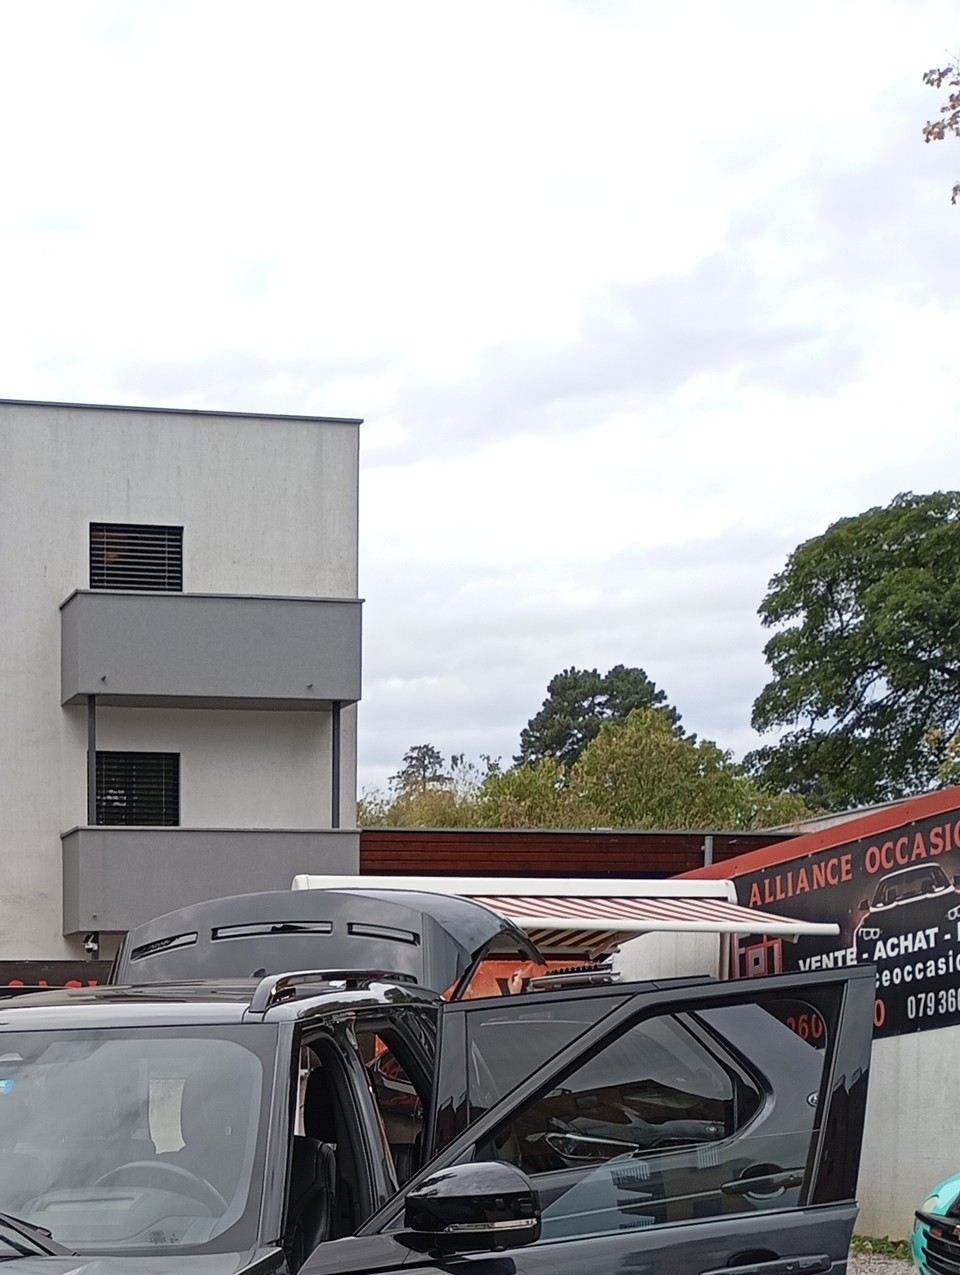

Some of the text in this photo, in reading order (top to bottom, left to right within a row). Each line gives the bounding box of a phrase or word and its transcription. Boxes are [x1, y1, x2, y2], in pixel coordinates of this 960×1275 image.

[749, 853, 853, 907] ALLIANCE
[798, 947, 858, 971] VENTE
[873, 927, 939, 961] ACHAT
[907, 992, 935, 1019] 079
